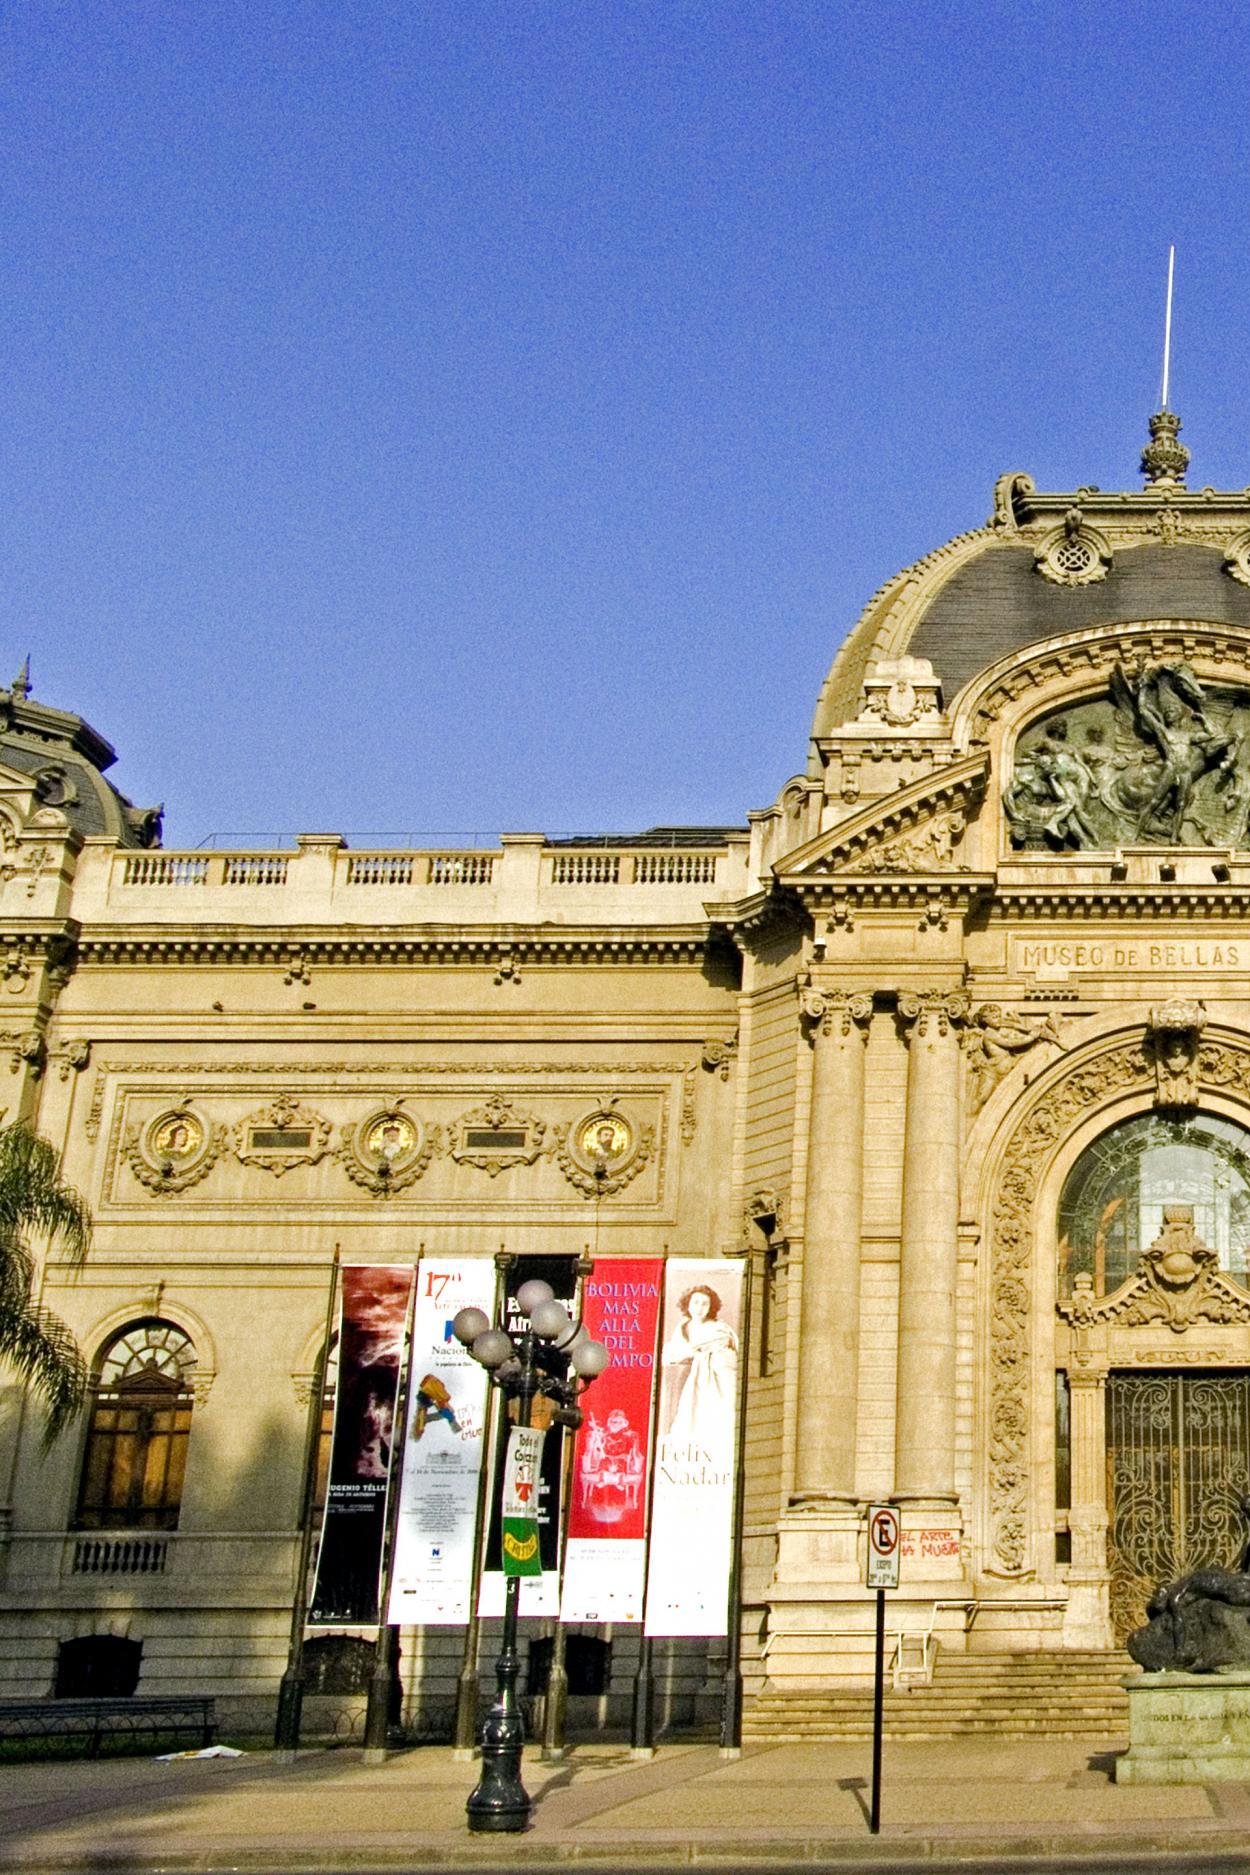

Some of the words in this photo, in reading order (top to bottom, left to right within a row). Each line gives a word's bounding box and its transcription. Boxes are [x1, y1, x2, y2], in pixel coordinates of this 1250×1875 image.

[1024, 946, 1103, 966] MUSEO
[1115, 949, 1138, 966] DE
[1150, 945, 1240, 966] BELLAS
[587, 1282, 659, 1297] BOLIVIA
[604, 1335, 633, 1350] DEL
